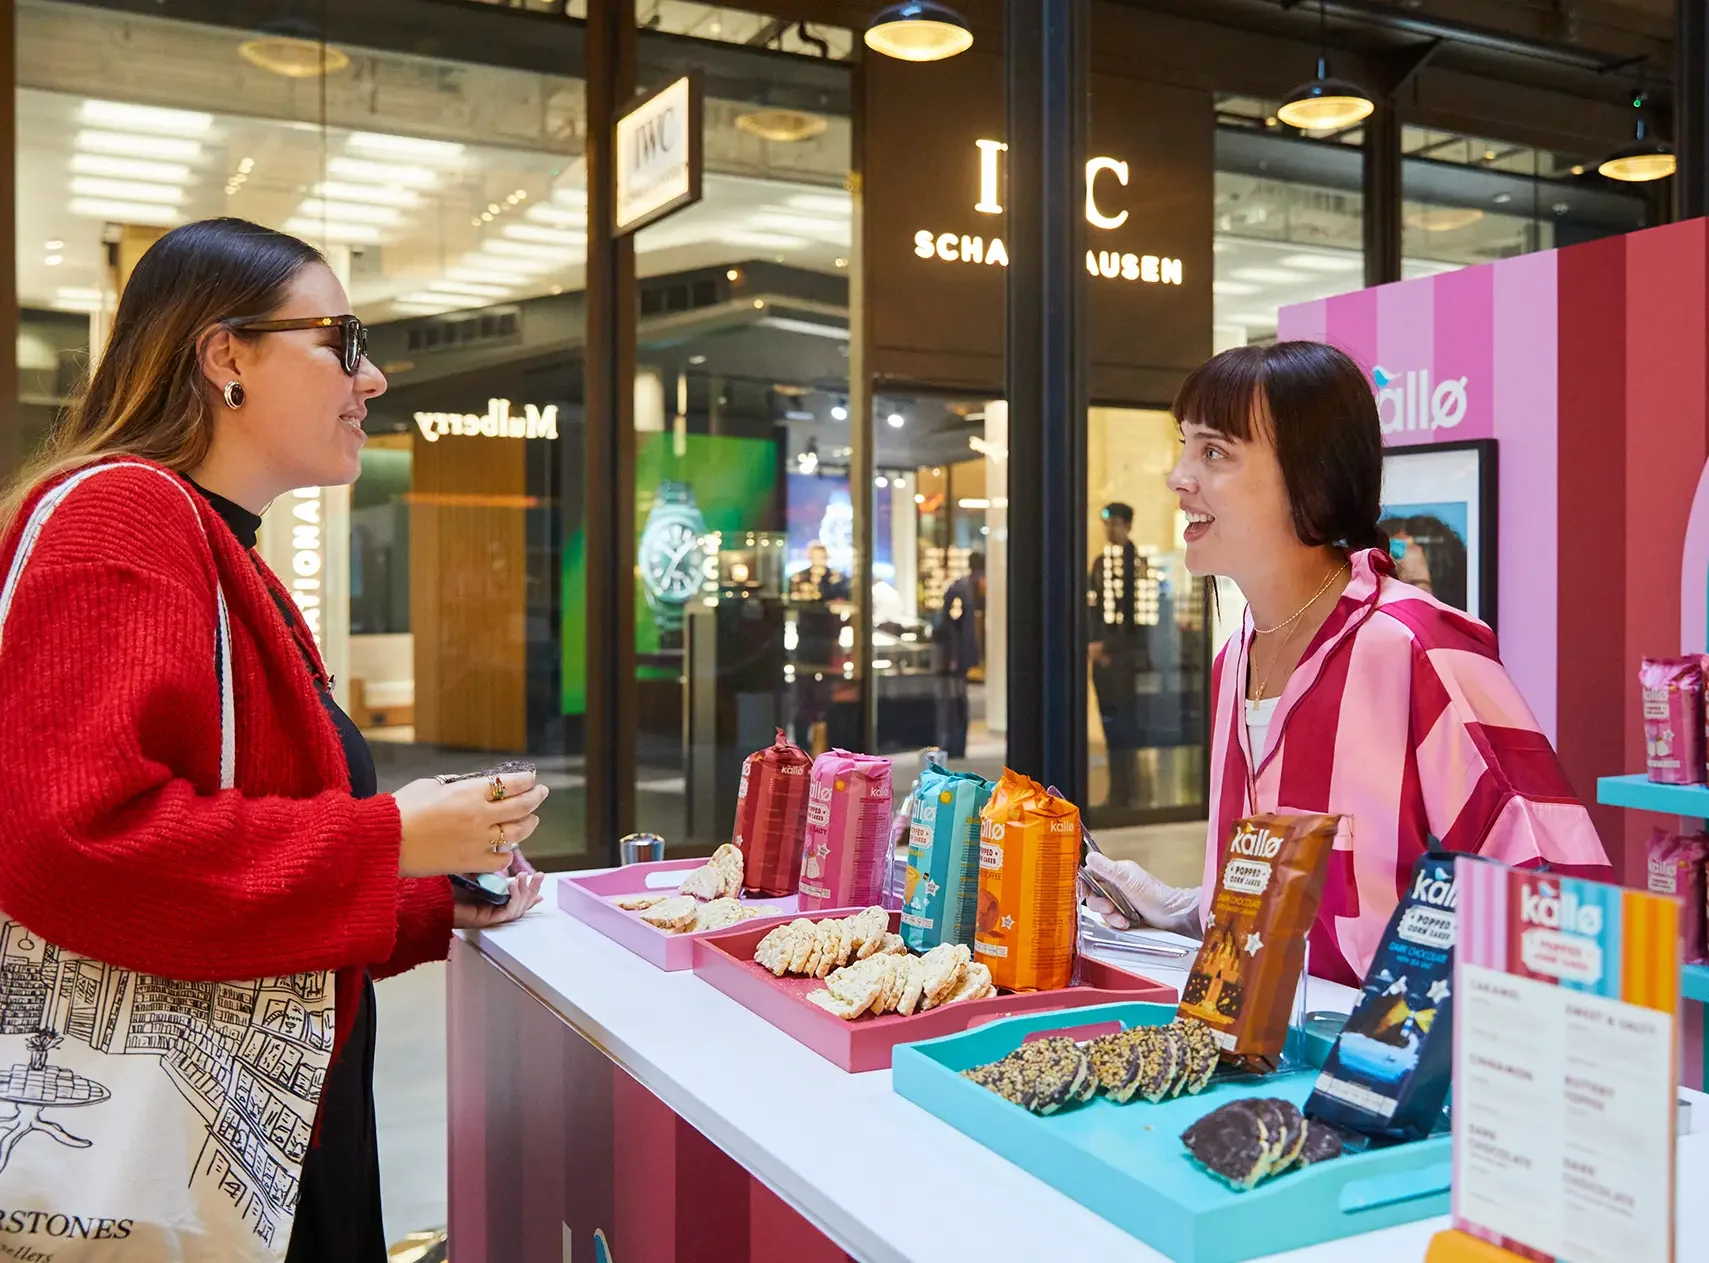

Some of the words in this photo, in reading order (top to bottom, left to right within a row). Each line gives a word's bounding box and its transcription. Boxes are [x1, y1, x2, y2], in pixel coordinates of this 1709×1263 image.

[633, 106, 674, 171] IWC
[974, 138, 1129, 230] IC
[914, 229, 1182, 286] SCHAAUSEN
[1235, 866, 1262, 877] POPPED
[1407, 924, 1427, 935] CORN
[1417, 914, 1451, 930] POPPED
